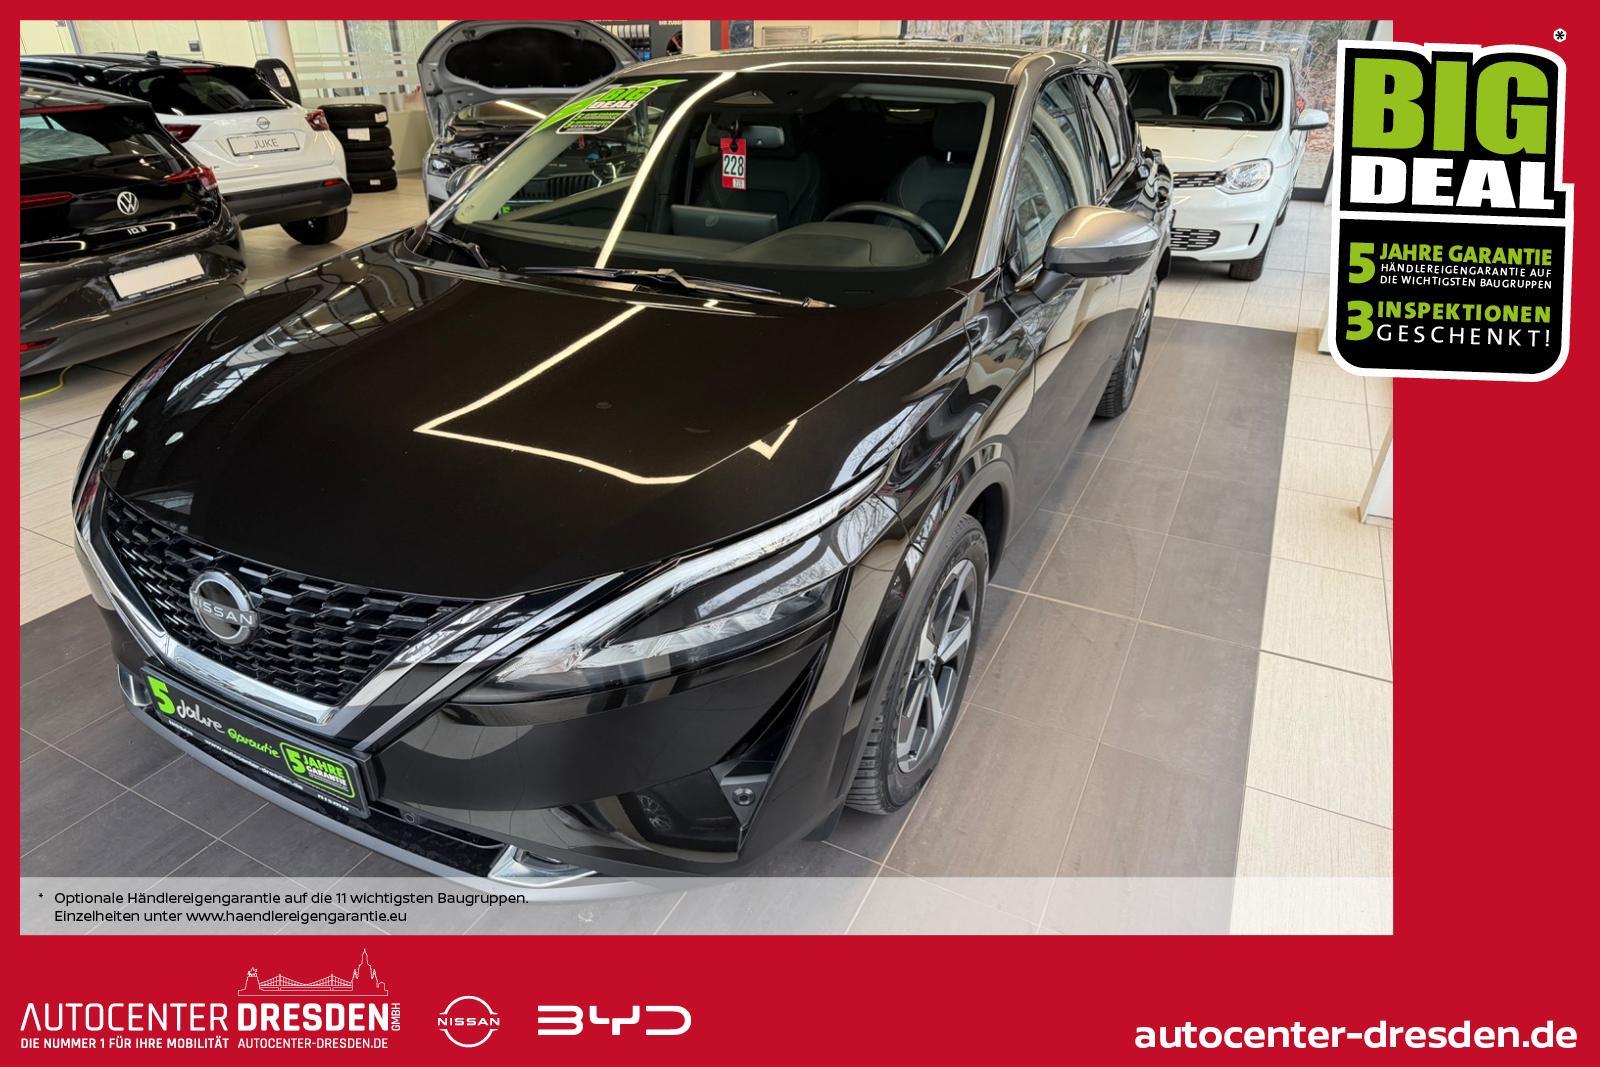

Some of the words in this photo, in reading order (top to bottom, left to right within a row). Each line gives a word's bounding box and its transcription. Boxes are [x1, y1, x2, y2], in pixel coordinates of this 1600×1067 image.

[254, 138, 279, 149] JUKE
[723, 154, 744, 177] 228
[147, 675, 176, 715] 5
[286, 748, 306, 774] 5
[303, 754, 344, 779] JAHRE
[306, 765, 347, 786] GARANTIE
